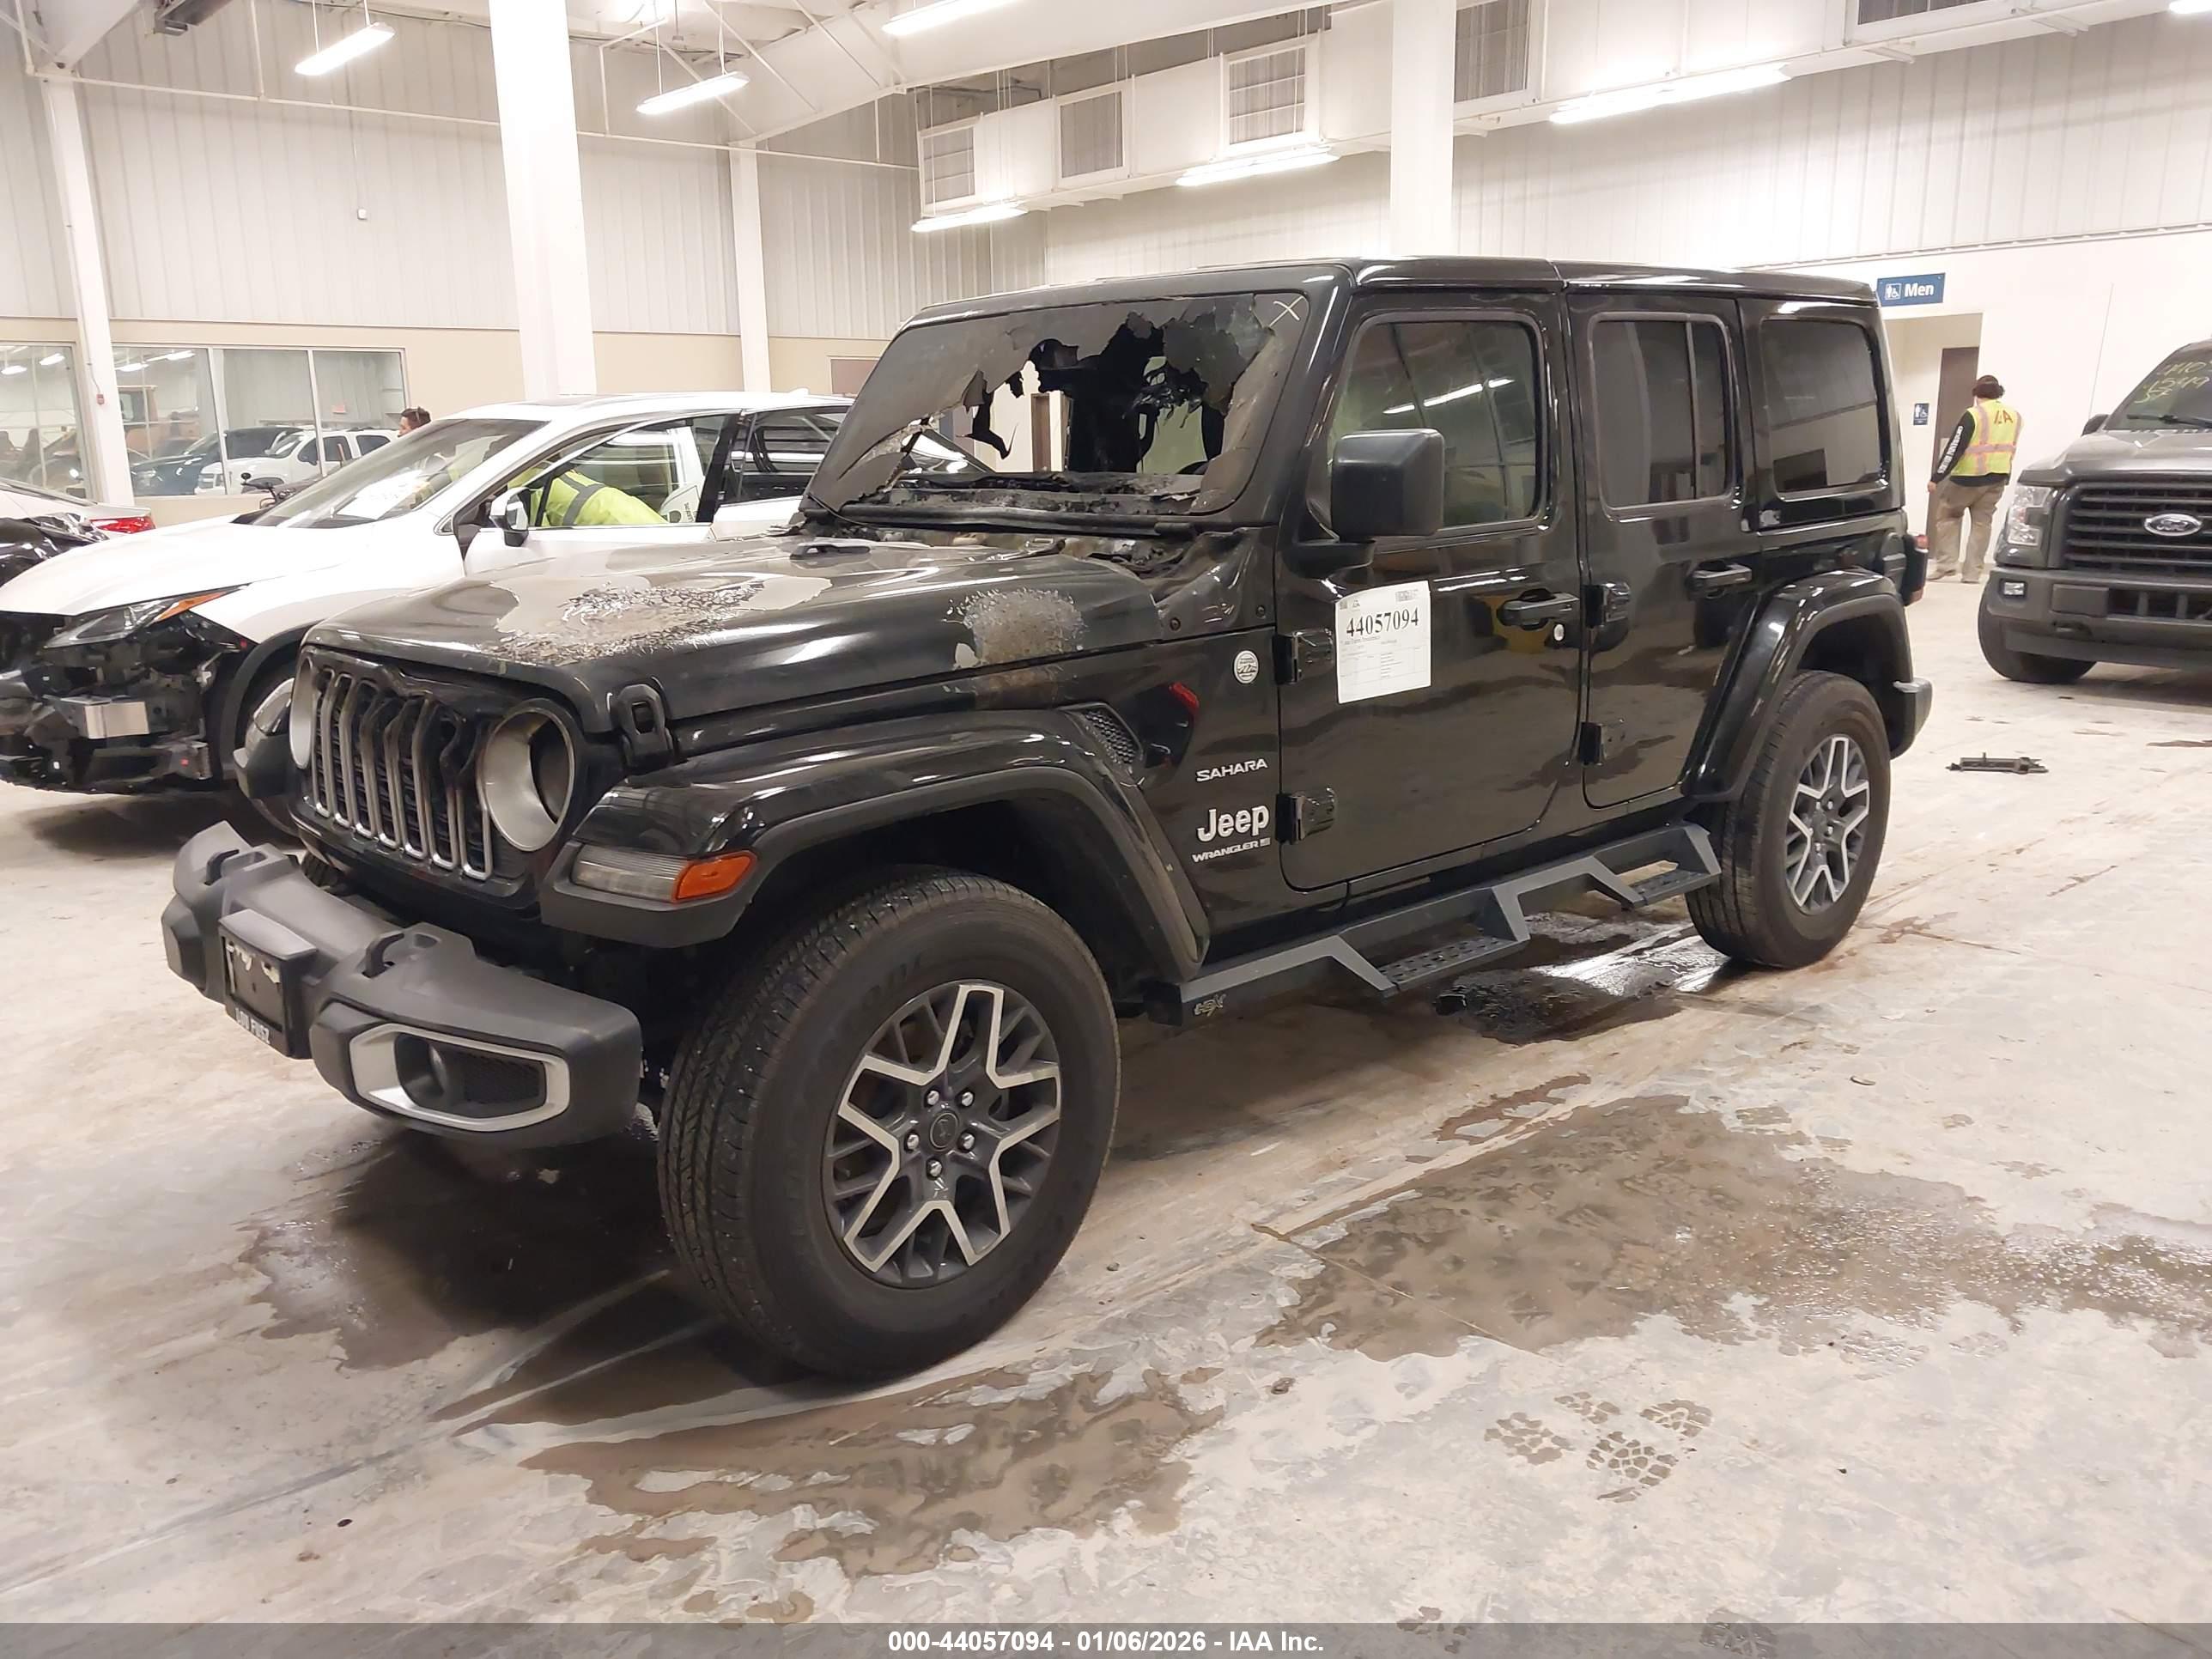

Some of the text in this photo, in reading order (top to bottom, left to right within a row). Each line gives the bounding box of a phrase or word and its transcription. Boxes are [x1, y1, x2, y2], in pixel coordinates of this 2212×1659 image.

[1904, 283, 1935, 297] Men
[1346, 607, 1419, 637] 44057094
[1196, 758, 1268, 782] SAHARA
[1197, 805, 1269, 842] Jeep
[1192, 841, 1259, 863] WRANGLER
